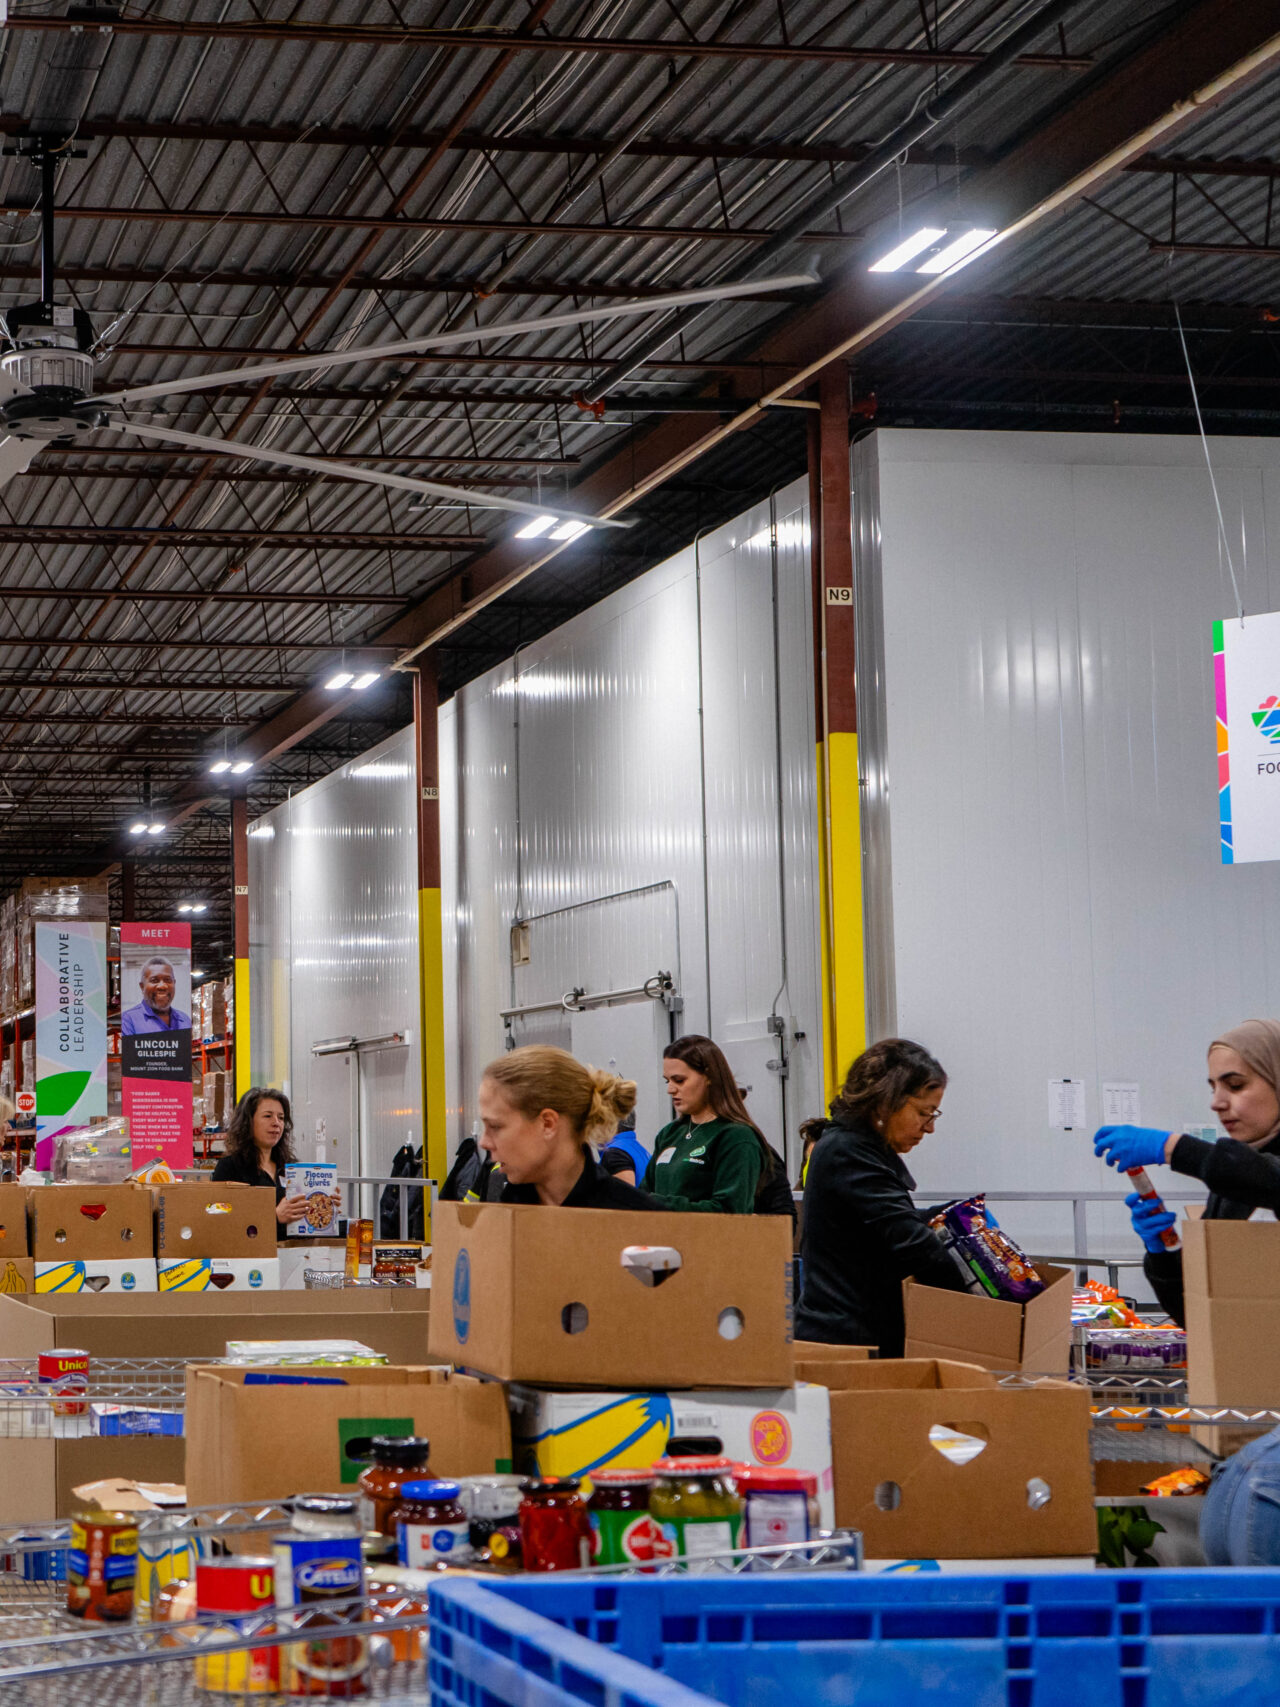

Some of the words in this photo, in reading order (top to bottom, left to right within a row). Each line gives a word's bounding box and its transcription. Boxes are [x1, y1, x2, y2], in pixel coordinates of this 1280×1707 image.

[829, 589, 850, 601] N9
[424, 788, 438, 796] N8
[141, 929, 170, 938] MEET
[59, 933, 70, 1052] COLLABORATIVE
[74, 963, 85, 1052] LEADERSHIP
[134, 1040, 179, 1049] LINCOLN
[18, 1098, 34, 1106] STOP
[305, 1171, 333, 1179] Flocons
[58, 1360, 88, 1372] Unico
